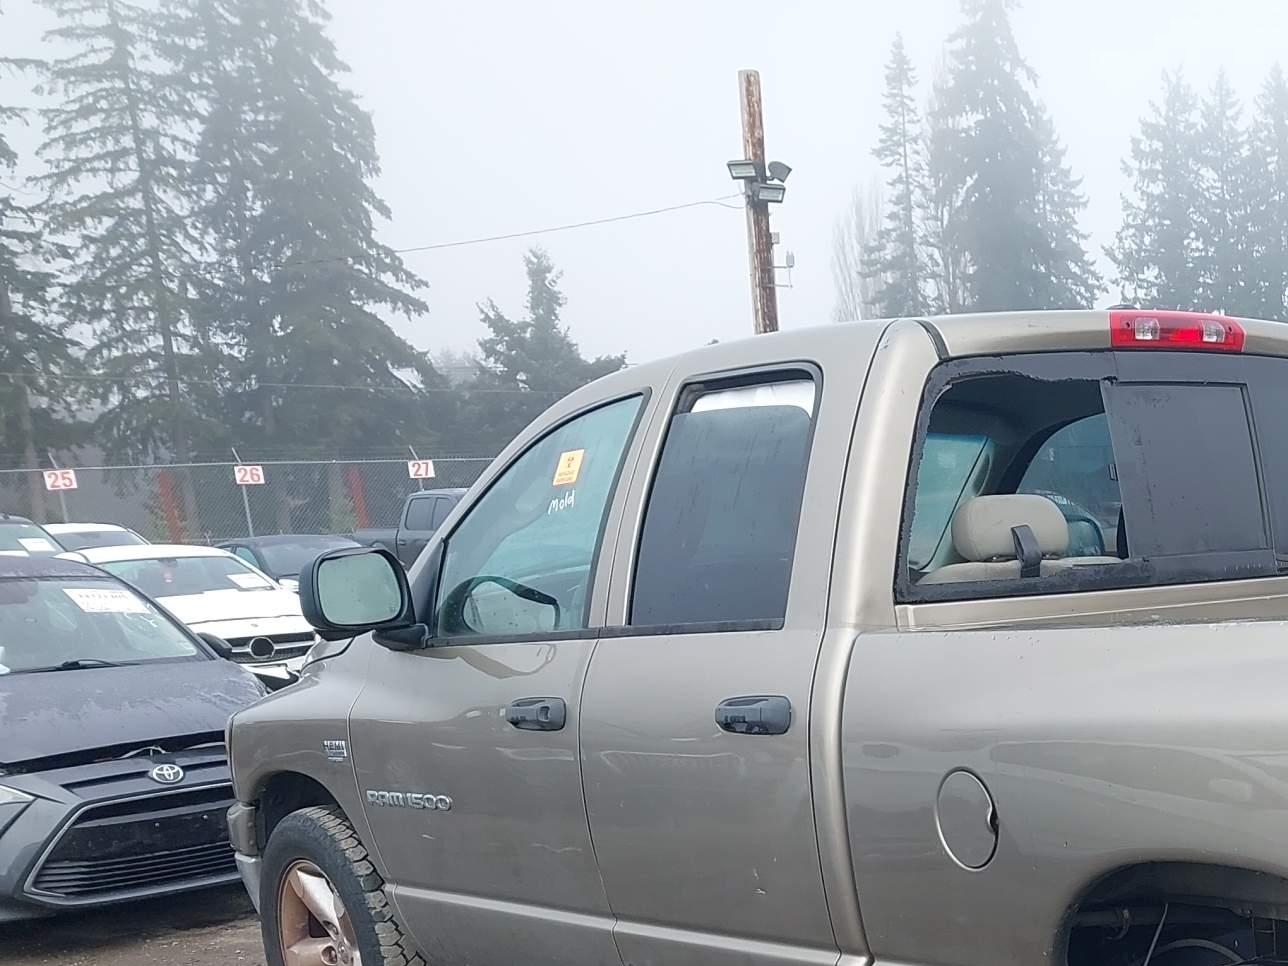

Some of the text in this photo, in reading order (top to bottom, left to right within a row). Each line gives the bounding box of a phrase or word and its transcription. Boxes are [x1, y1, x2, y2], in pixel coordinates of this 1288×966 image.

[237, 467, 261, 483] 26
[411, 462, 430, 477] 27
[47, 471, 73, 489] 25
[547, 488, 576, 515] Mold
[366, 789, 452, 811] RAM 1500
